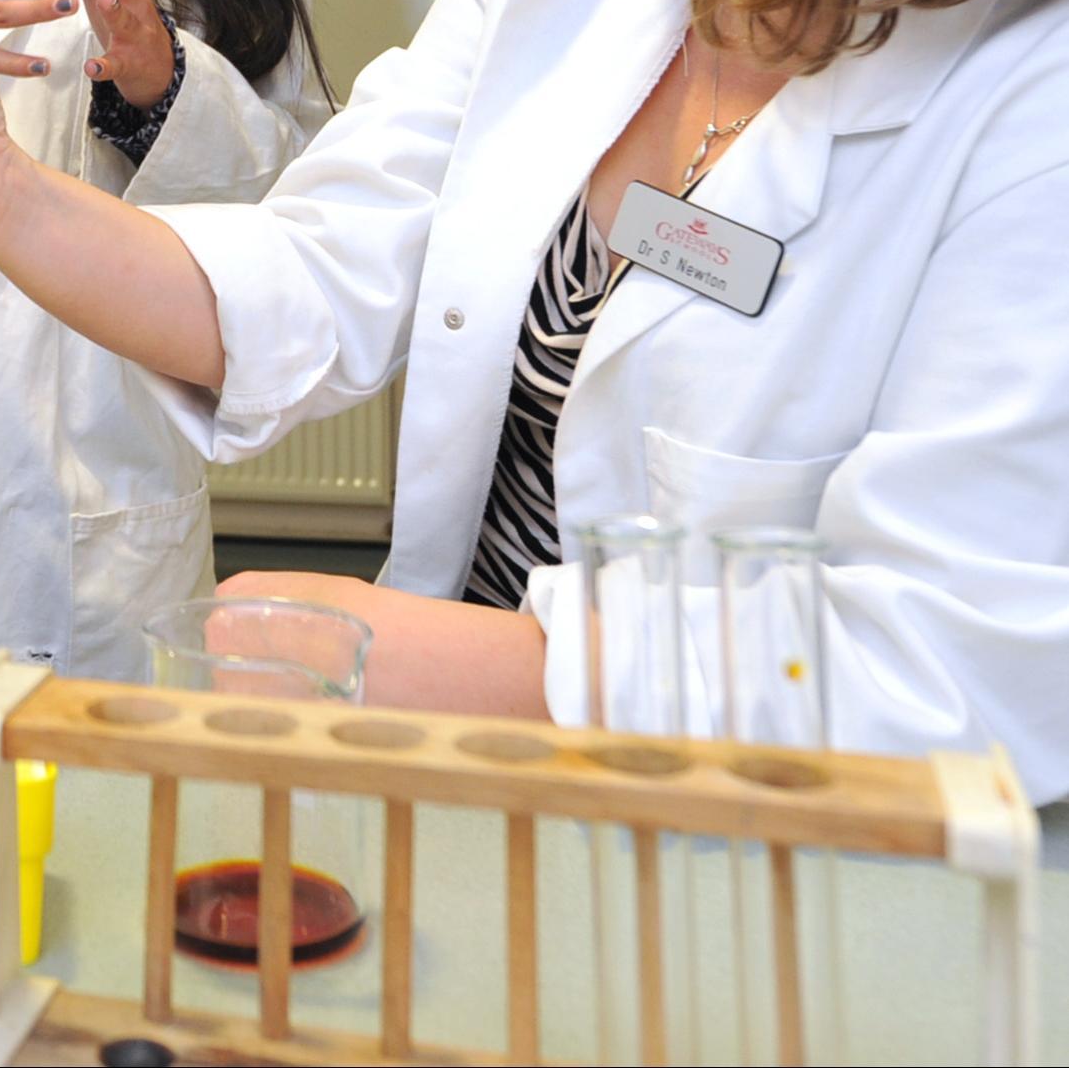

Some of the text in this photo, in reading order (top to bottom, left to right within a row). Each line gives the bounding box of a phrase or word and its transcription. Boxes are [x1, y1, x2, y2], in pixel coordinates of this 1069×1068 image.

[637, 240, 654, 257] Dr
[660, 249, 671, 265] S
[676, 257, 728, 291] Newton
